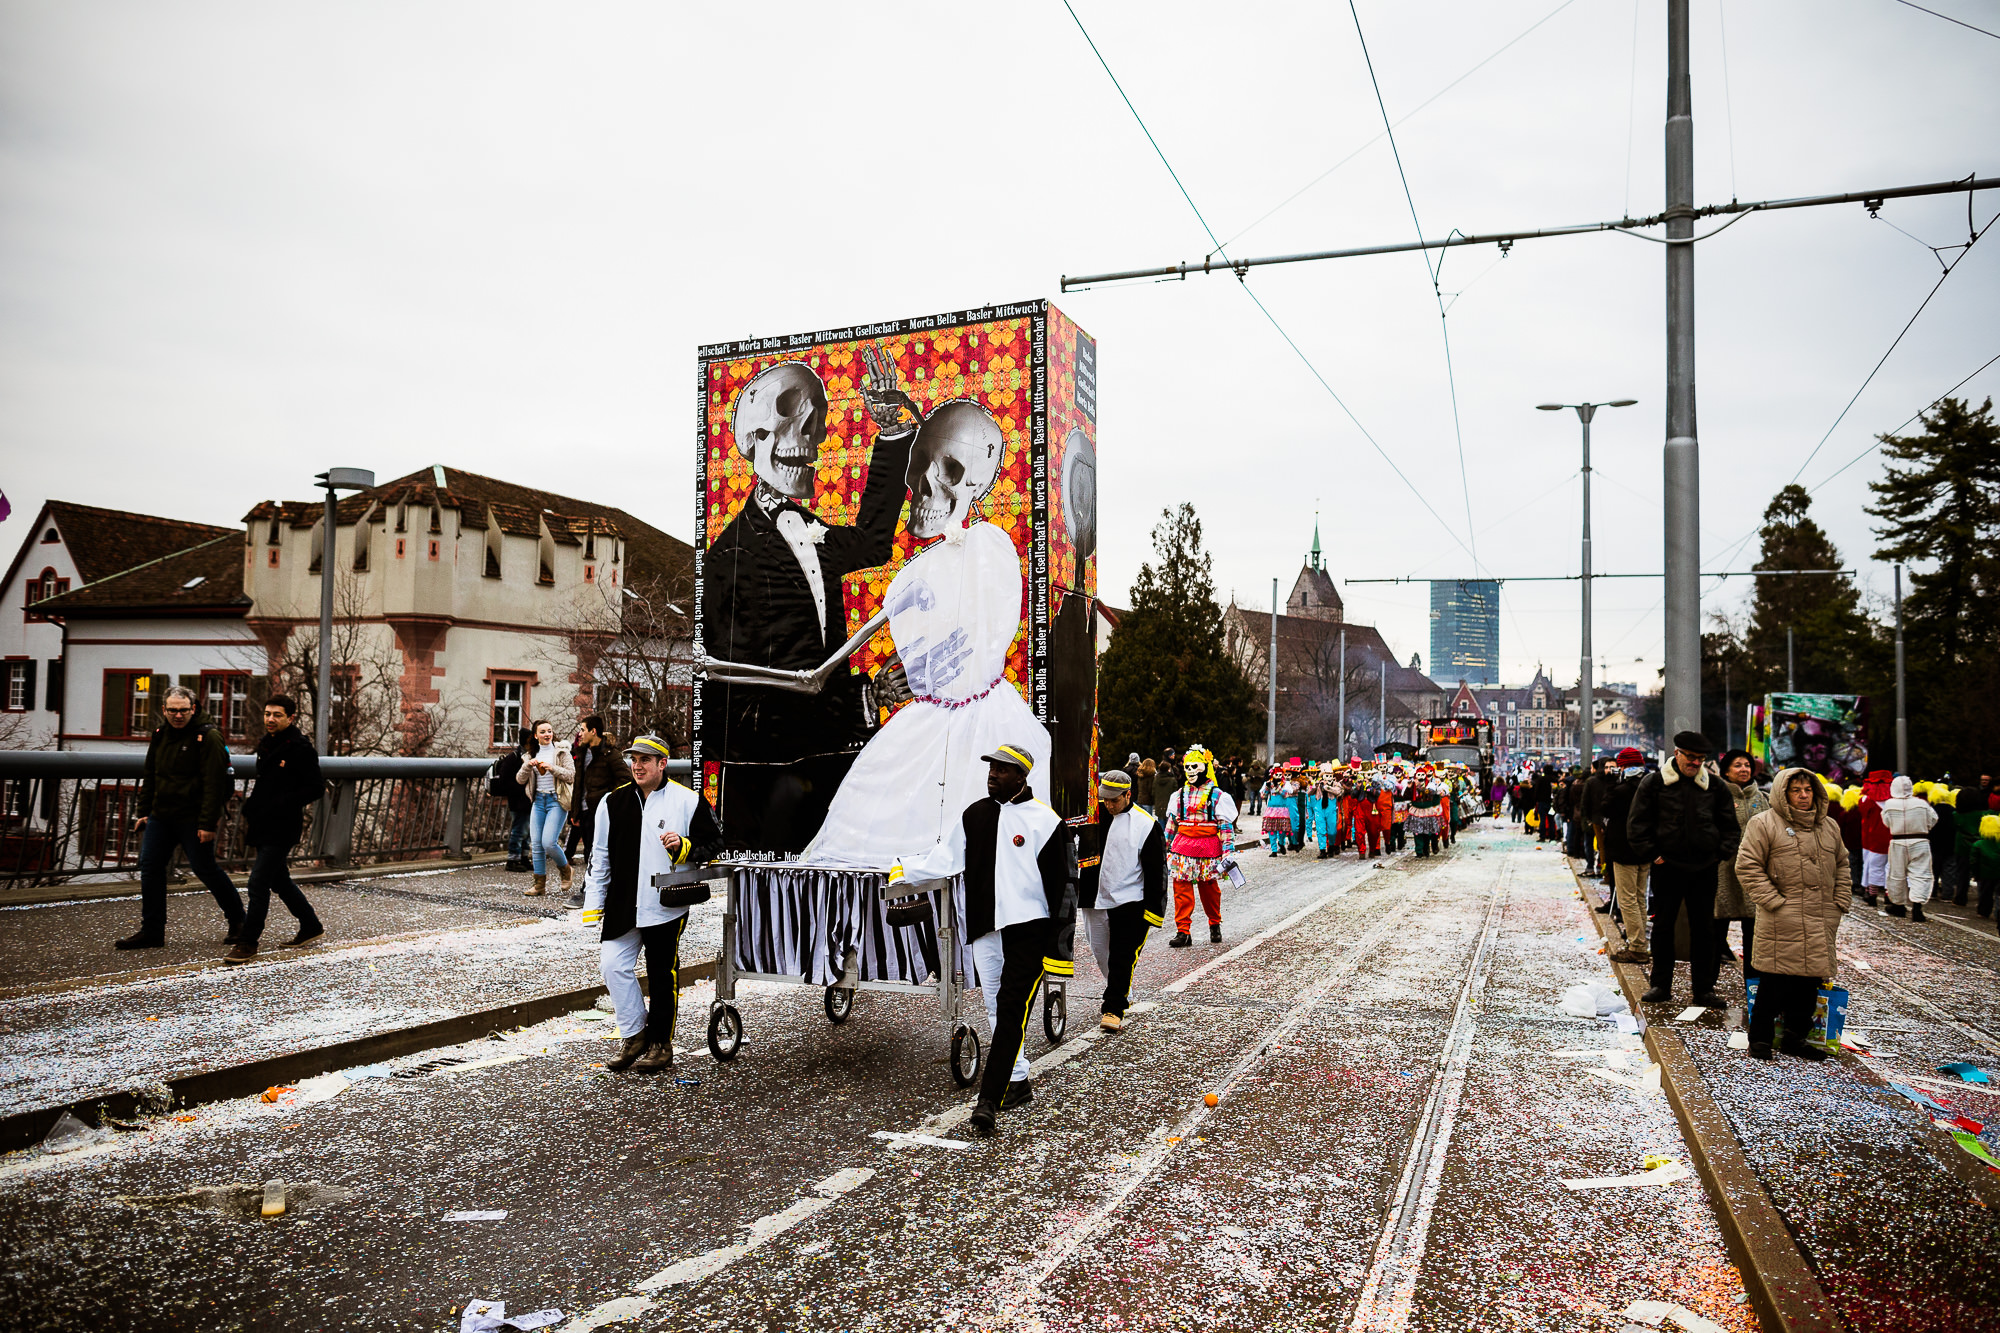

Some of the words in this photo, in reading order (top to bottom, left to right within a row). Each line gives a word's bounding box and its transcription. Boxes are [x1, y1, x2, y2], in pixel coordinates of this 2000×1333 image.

[739, 341, 760, 352] Morta
[763, 338, 780, 348] Bella
[789, 333, 812, 345] Basler
[815, 328, 852, 342] Mittwuch
[855, 321, 900, 336] Gsellschaft
[909, 318, 934, 330] Morta
[937, 312, 956, 325] Bella
[966, 308, 993, 321] Basler
[995, 301, 1038, 317] Mittwuch
[1041, 300, 1048, 311] G
[698, 362, 707, 388] Basler
[1033, 366, 1045, 412] Mittwuch
[697, 391, 706, 431] Mittwuch
[1033, 415, 1045, 445] Basler
[696, 434, 706, 482] Gsellschaft
[1034, 455, 1045, 478] Bella
[696, 491, 705, 517] Morta
[1034, 481, 1046, 510] Morta
[696, 519, 705, 540] Bella
[1034, 520, 1046, 574] Gsellschaft
[695, 548, 705, 576] Basler
[694, 578, 704, 621] Mittwuch
[1035, 576, 1047, 624] Mittwuch
[1035, 627, 1047, 657] Basler
[1035, 667, 1047, 691] Bella
[693, 681, 703, 707] Morta
[1035, 694, 1047, 723] Morta
[693, 709, 703, 730] Bella
[693, 740, 703, 767] Basler
[733, 850, 775, 861] Gsellschaft
